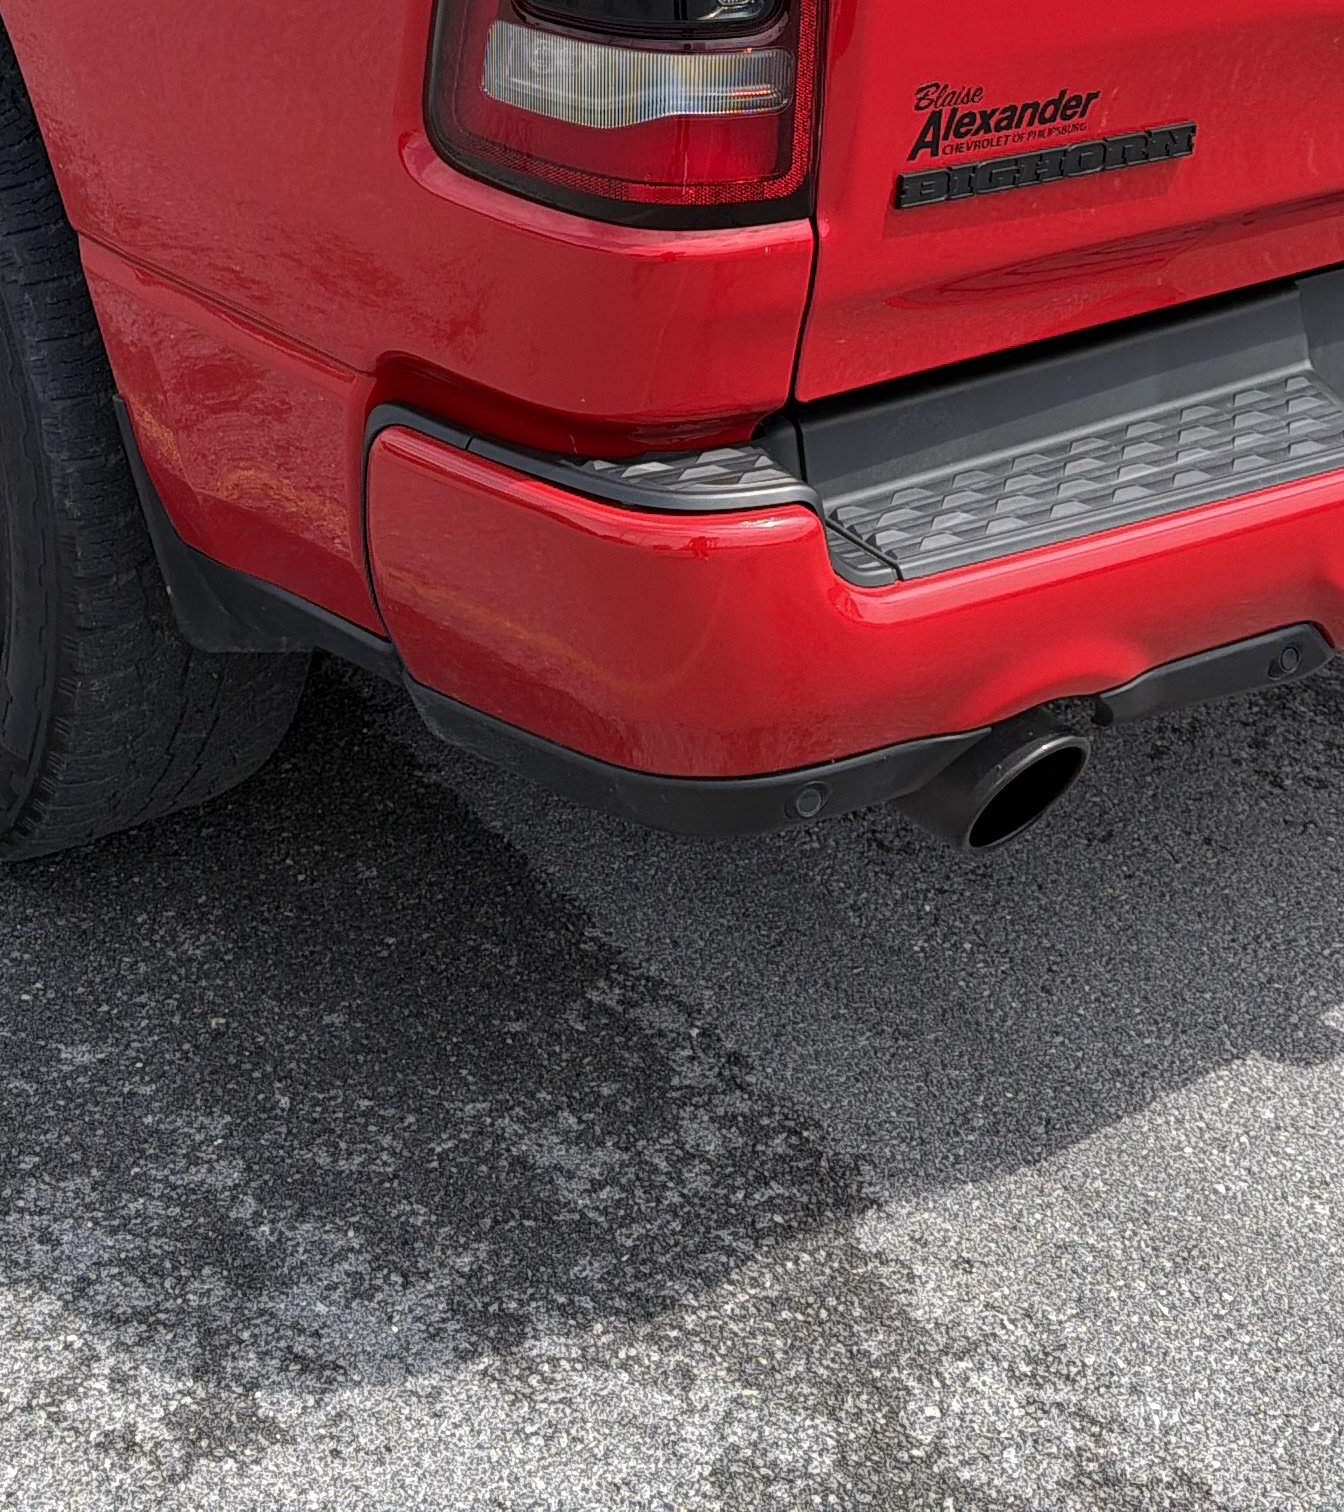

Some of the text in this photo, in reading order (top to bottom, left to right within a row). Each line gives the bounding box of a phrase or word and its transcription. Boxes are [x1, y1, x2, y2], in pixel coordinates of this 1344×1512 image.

[913, 82, 984, 112] Blaise
[907, 88, 1101, 162] Alexander
[942, 133, 1010, 156] CHEVROLET
[1012, 131, 1027, 143] OF
[894, 120, 1198, 210] BIGHORN
